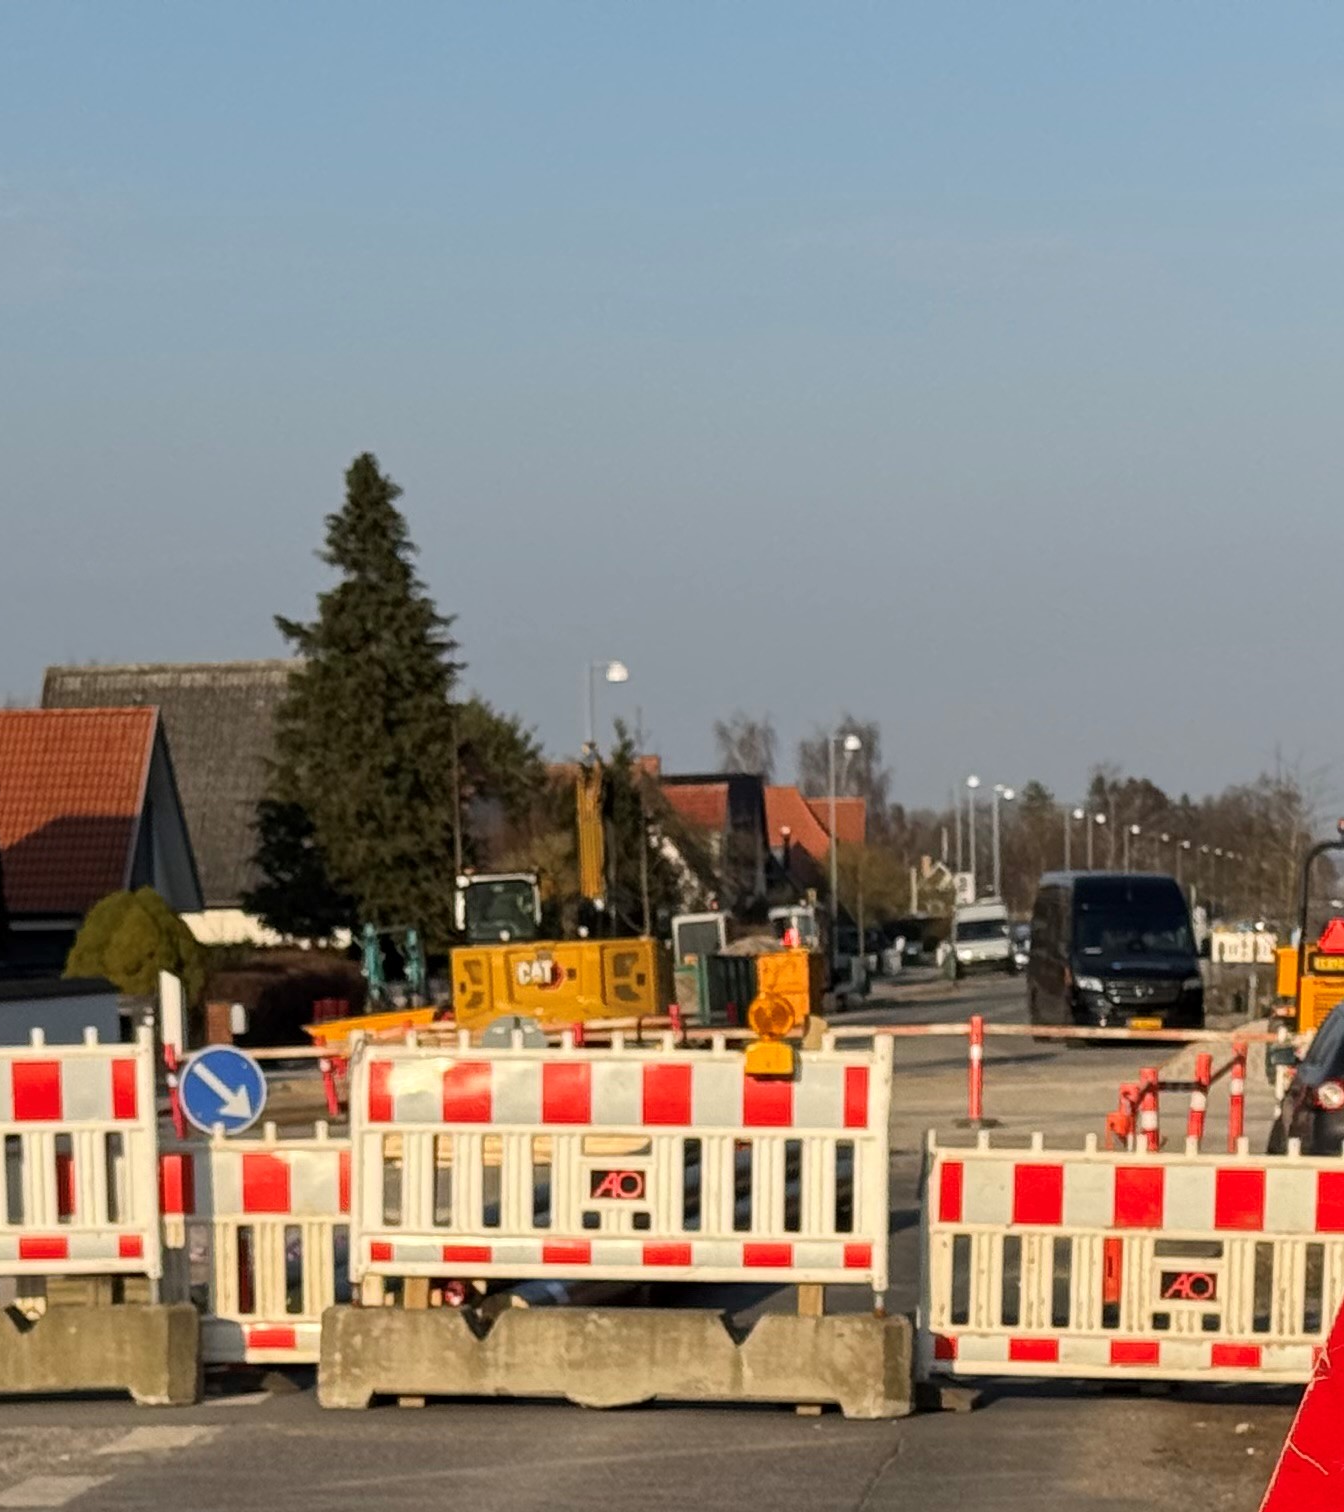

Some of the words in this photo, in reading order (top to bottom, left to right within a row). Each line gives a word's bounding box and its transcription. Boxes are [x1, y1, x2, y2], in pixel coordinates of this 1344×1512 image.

[518, 960, 553, 985] CAT
[594, 1170, 643, 1199] AO
[1164, 1273, 1214, 1300] AO
